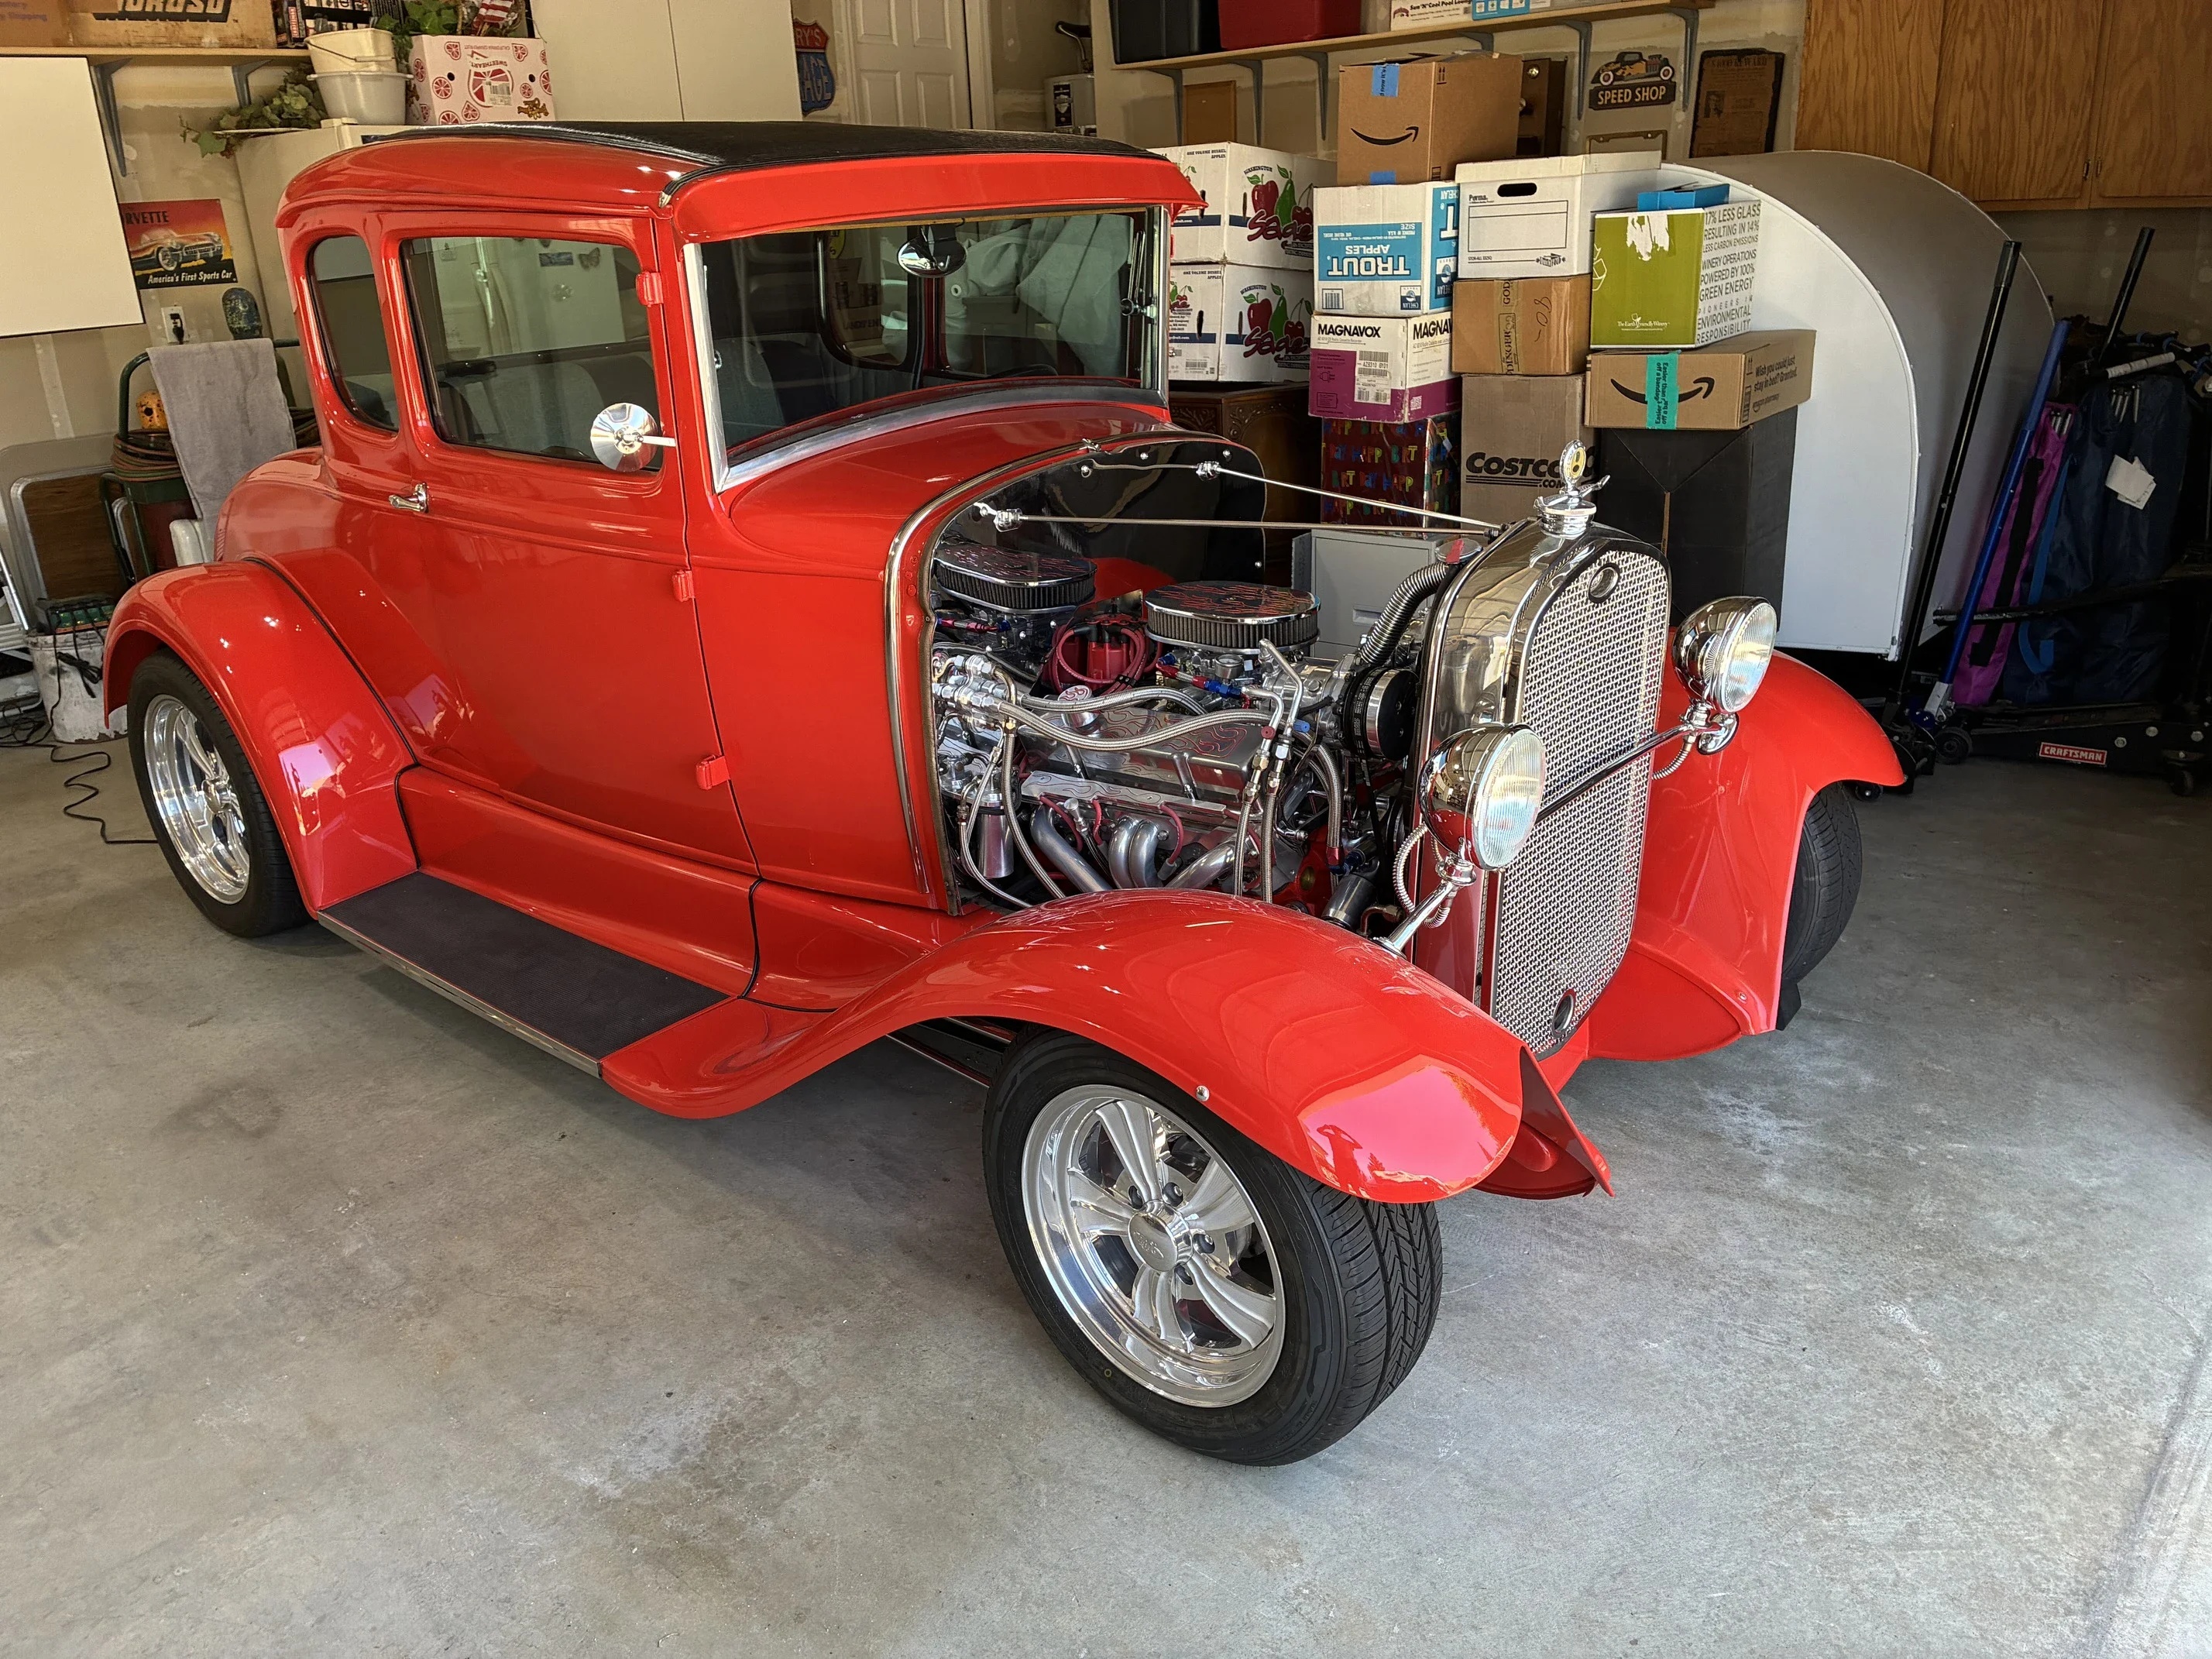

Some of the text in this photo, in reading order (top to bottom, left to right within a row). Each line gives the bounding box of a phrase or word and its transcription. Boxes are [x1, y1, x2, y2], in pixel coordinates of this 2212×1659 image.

[1597, 85, 1666, 105] SPEED SHOP
[1705, 203, 1761, 225] 17% LESS GLASS
[1704, 219, 1760, 241] RESULTING IN 14%
[1345, 244, 1390, 255] APPLES
[1702, 234, 1758, 253] LESS CARBON EMISSIONS
[1327, 255, 1411, 277] TROUT
[1702, 249, 1757, 270] WINERY OPERATIONS
[148, 270, 232, 284] America's First Sports Car
[1700, 263, 1755, 286] POWERED BY 100%
[1698, 276, 1754, 302] GREEN ENERGY
[1698, 297, 1740, 315] PIONEERS
[1697, 304, 1751, 331] ENVIRONMENTAL
[1317, 323, 1382, 338] MAGNAVOX
[1696, 318, 1751, 344] RESPONSIBILITY
[1466, 452, 1561, 479] COSTCO
[2044, 746, 2103, 761] CRAFTSMAN
